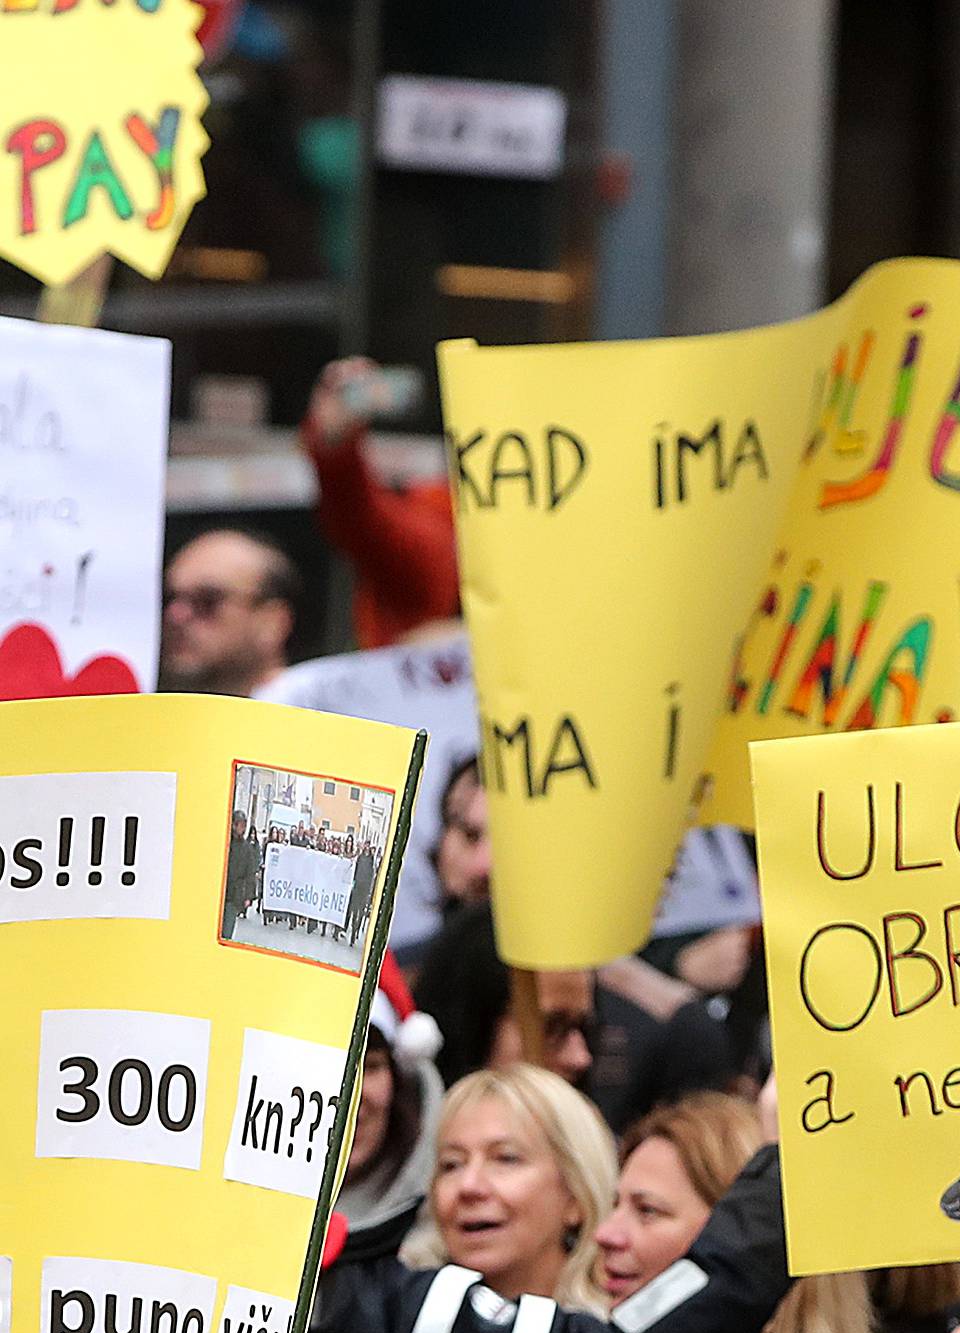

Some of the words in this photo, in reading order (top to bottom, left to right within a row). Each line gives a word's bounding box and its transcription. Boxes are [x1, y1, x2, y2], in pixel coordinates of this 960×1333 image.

[5, 104, 183, 237] PAY
[0, 815, 140, 890] s!!!
[269, 879, 293, 900] 96%
[294, 884, 320, 907] reklo
[318, 888, 331, 912] je
[330, 890, 348, 913] NE!
[54, 1056, 198, 1133] 300
[801, 1070, 856, 1133] a
